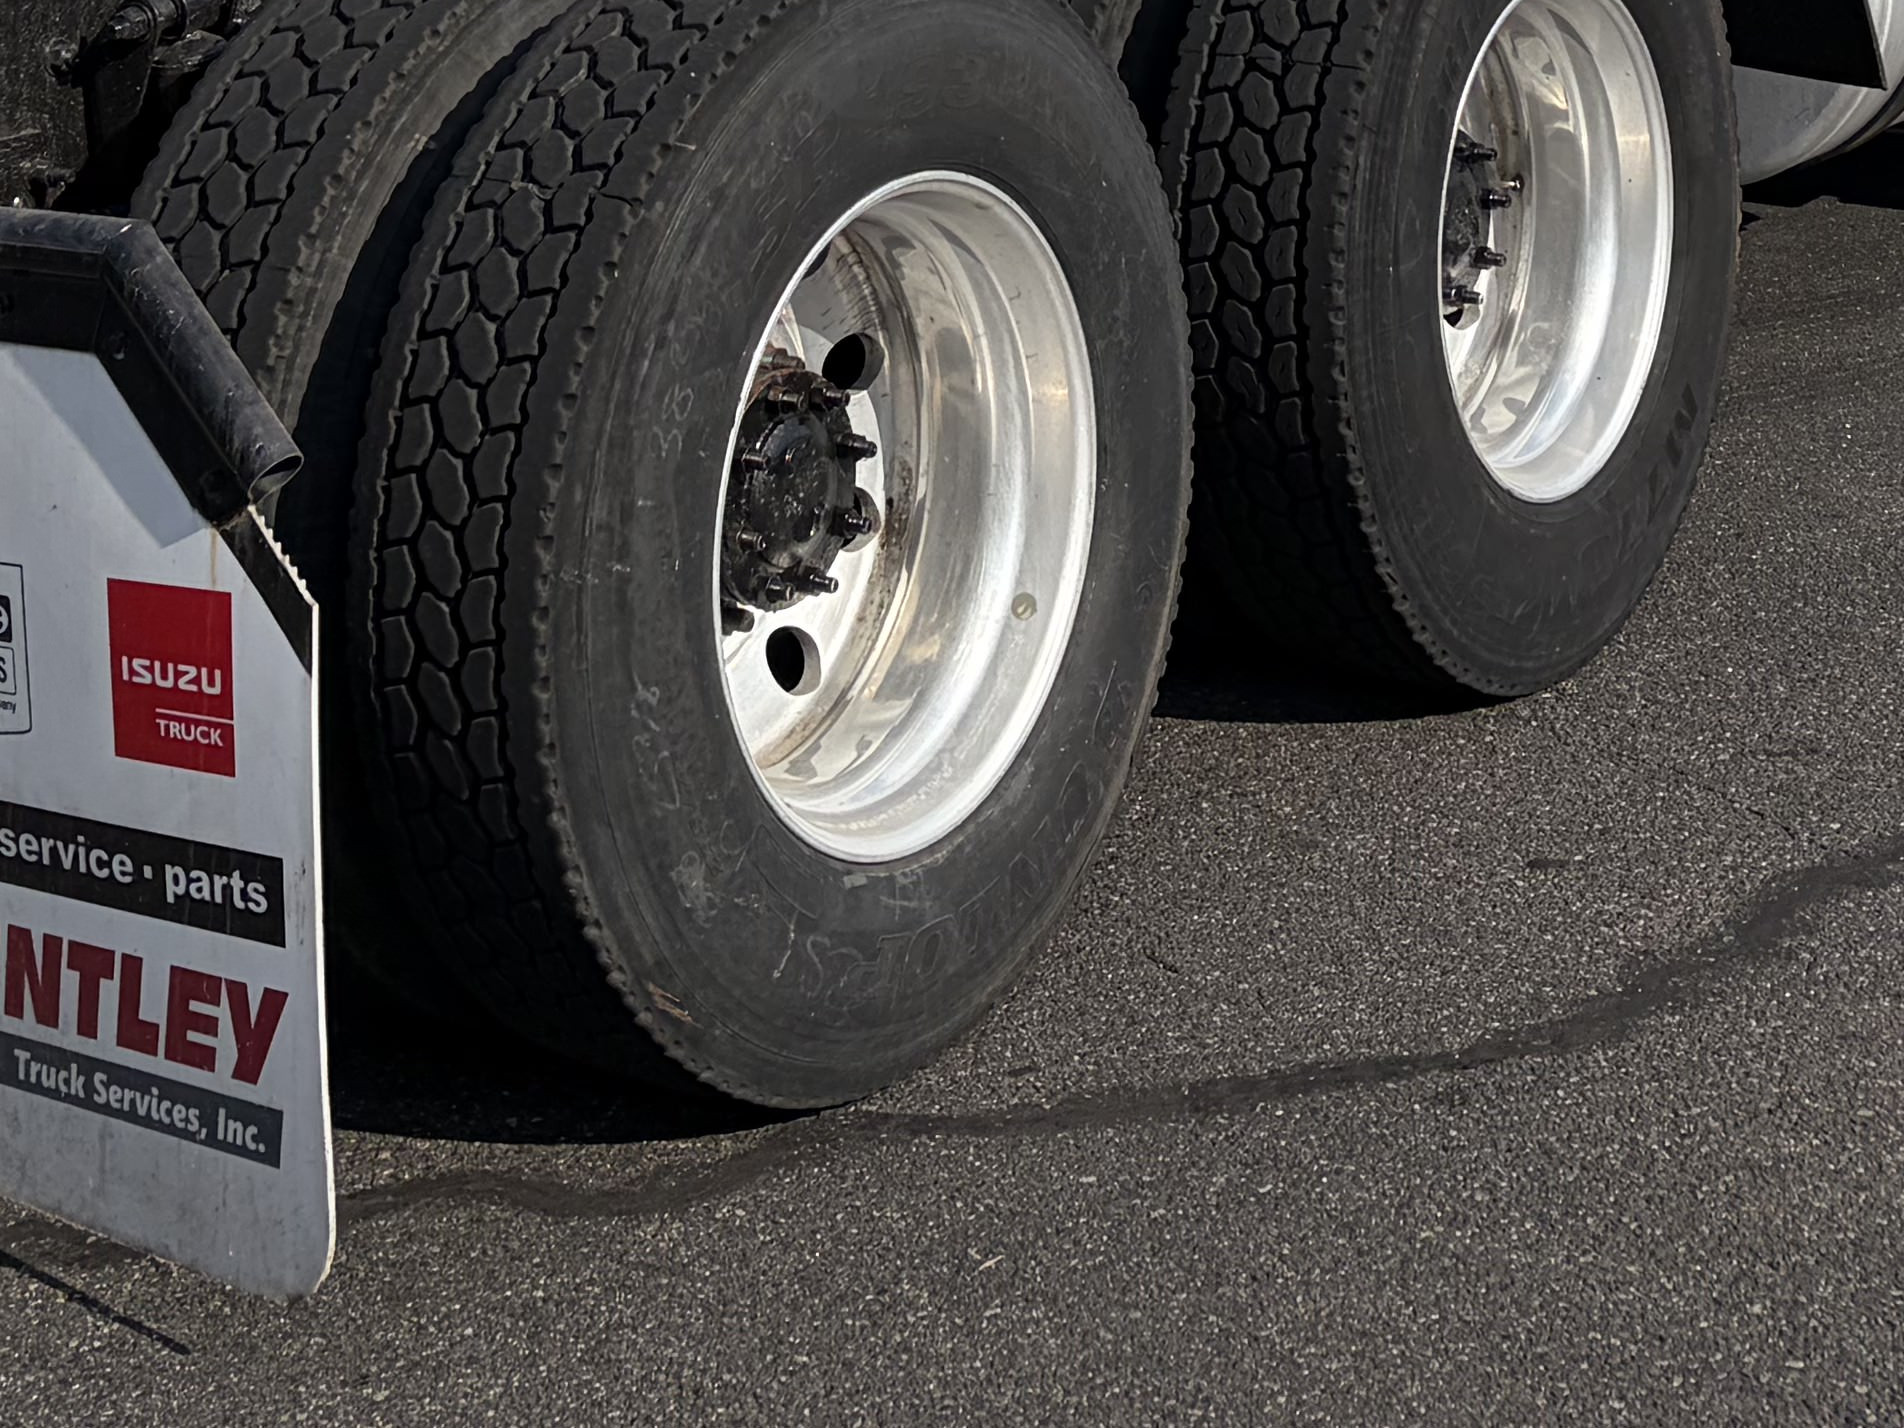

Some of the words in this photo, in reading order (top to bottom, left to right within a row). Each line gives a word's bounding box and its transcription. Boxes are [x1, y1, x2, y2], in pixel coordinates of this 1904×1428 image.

[121, 655, 222, 696] ISUZU
[155, 718, 224, 747] TRUCK
[165, 861, 269, 914] parts
[13, 1048, 85, 1099] Truck
[92, 1073, 208, 1139] Services,
[216, 1107, 267, 1154] Inc.
